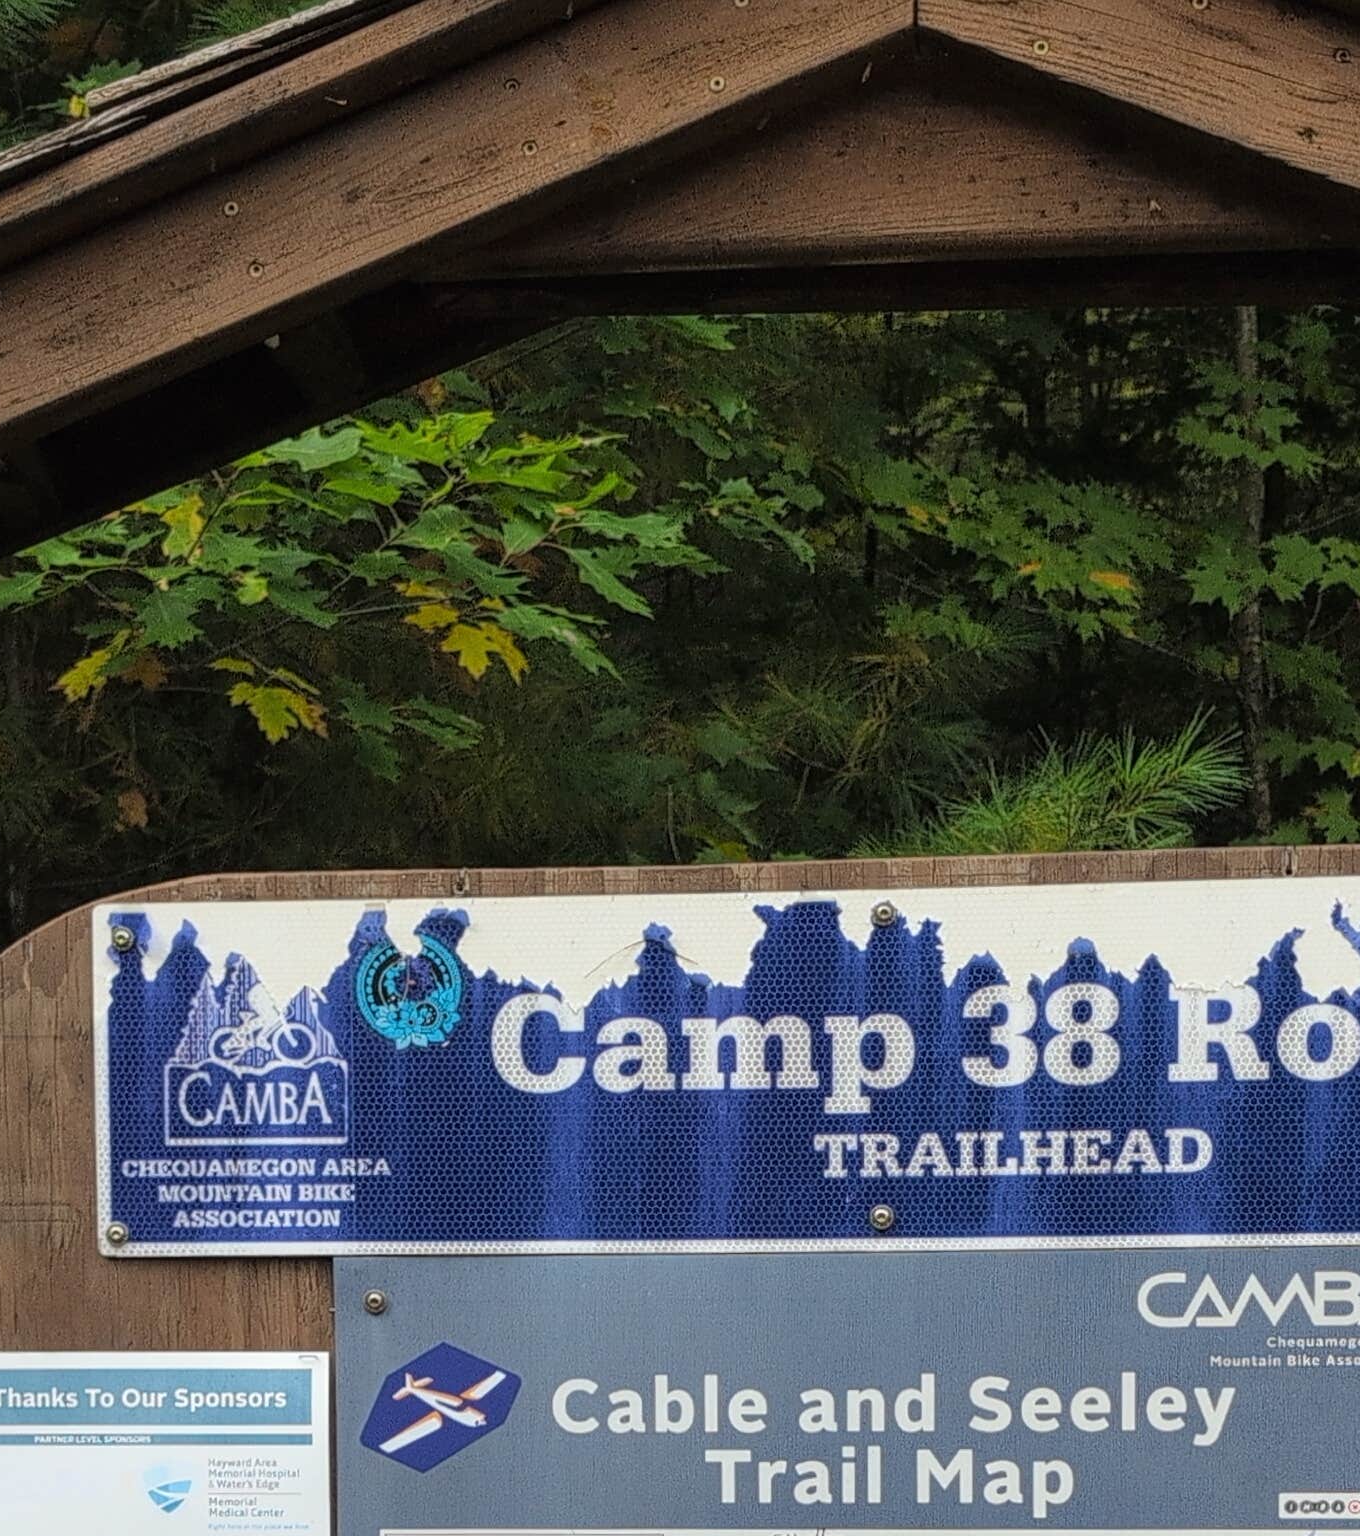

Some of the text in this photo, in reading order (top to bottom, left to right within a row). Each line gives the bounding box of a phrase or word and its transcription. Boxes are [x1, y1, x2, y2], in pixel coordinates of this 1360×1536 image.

[490, 994, 914, 1114] Camp
[963, 983, 1120, 1087] 38
[178, 1073, 333, 1128] CAMBA
[123, 1158, 390, 1178] CHEQUAMEGON AREA
[815, 1127, 1214, 1179] TRAILHEAD
[159, 1184, 355, 1202] MOUNTAIN BIKE
[174, 1210, 340, 1227] ASSOCIATION
[1211, 1355, 1281, 1366] Mountain
[1287, 1354, 1319, 1366] Bike
[85, 1389, 114, 1407] To
[122, 1388, 167, 1407] Our
[175, 1388, 286, 1412] Sponsors
[552, 1372, 1235, 1446] Cable and Seeley
[705, 1446, 1073, 1518] Trail Map
